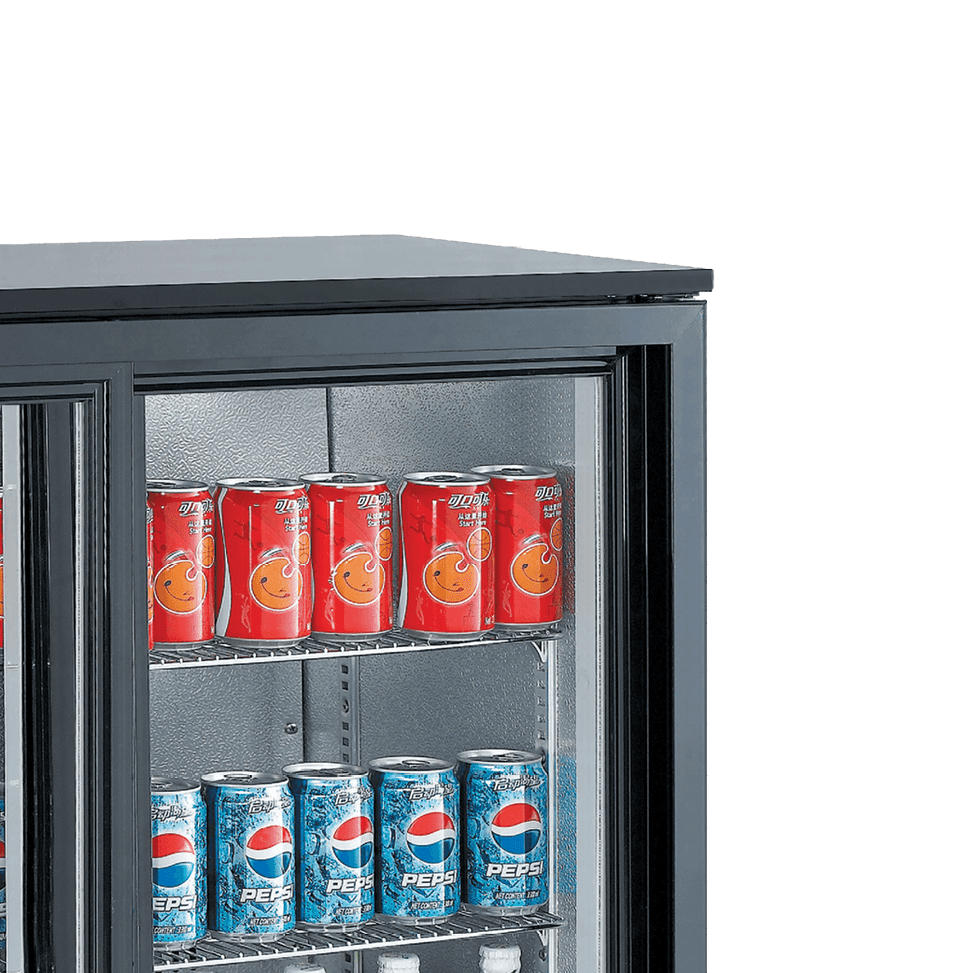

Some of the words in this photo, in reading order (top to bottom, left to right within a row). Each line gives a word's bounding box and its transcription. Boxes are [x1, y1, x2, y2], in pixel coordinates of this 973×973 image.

[448, 491, 490, 509] 可口可乐
[486, 860, 544, 878] PEPSI
[401, 869, 457, 888] PEPSI
[240, 884, 294, 903] PEPSI
[152, 894, 198, 912] EPSI
